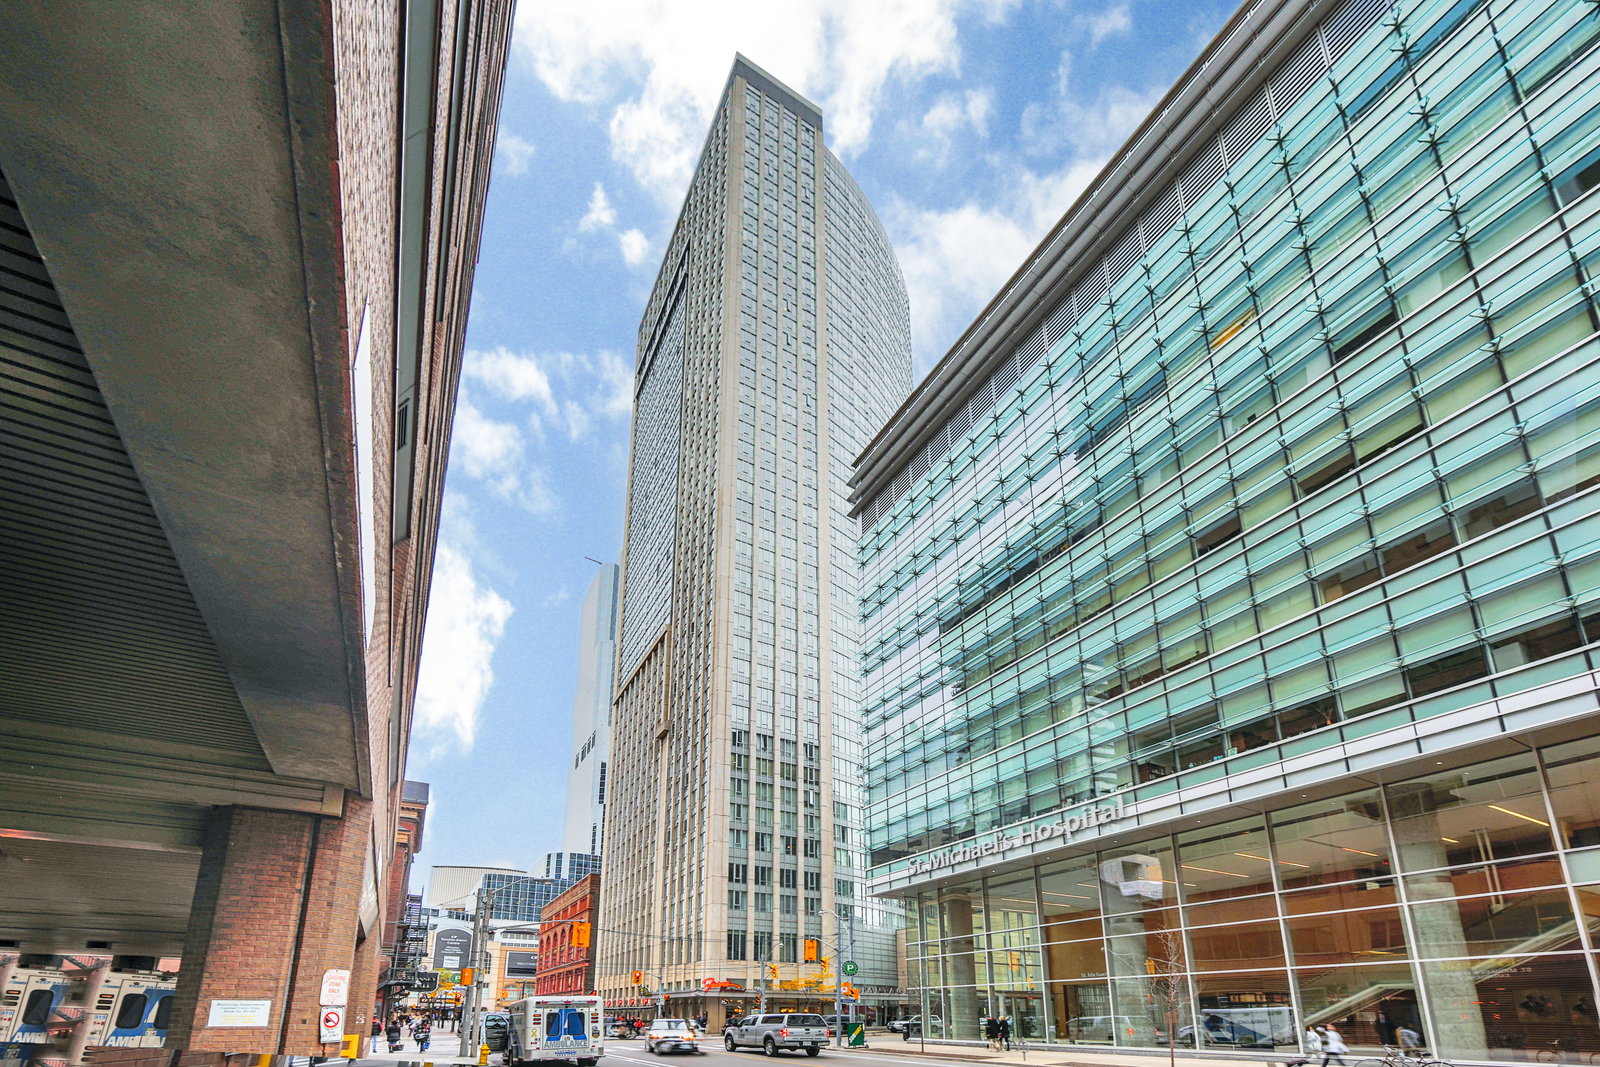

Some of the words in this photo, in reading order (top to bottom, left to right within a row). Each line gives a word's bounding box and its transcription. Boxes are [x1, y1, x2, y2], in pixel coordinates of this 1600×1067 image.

[908, 857, 930, 877] St.
[1019, 794, 1126, 839] Hospital
[544, 1039, 588, 1049] AMBULANCE
